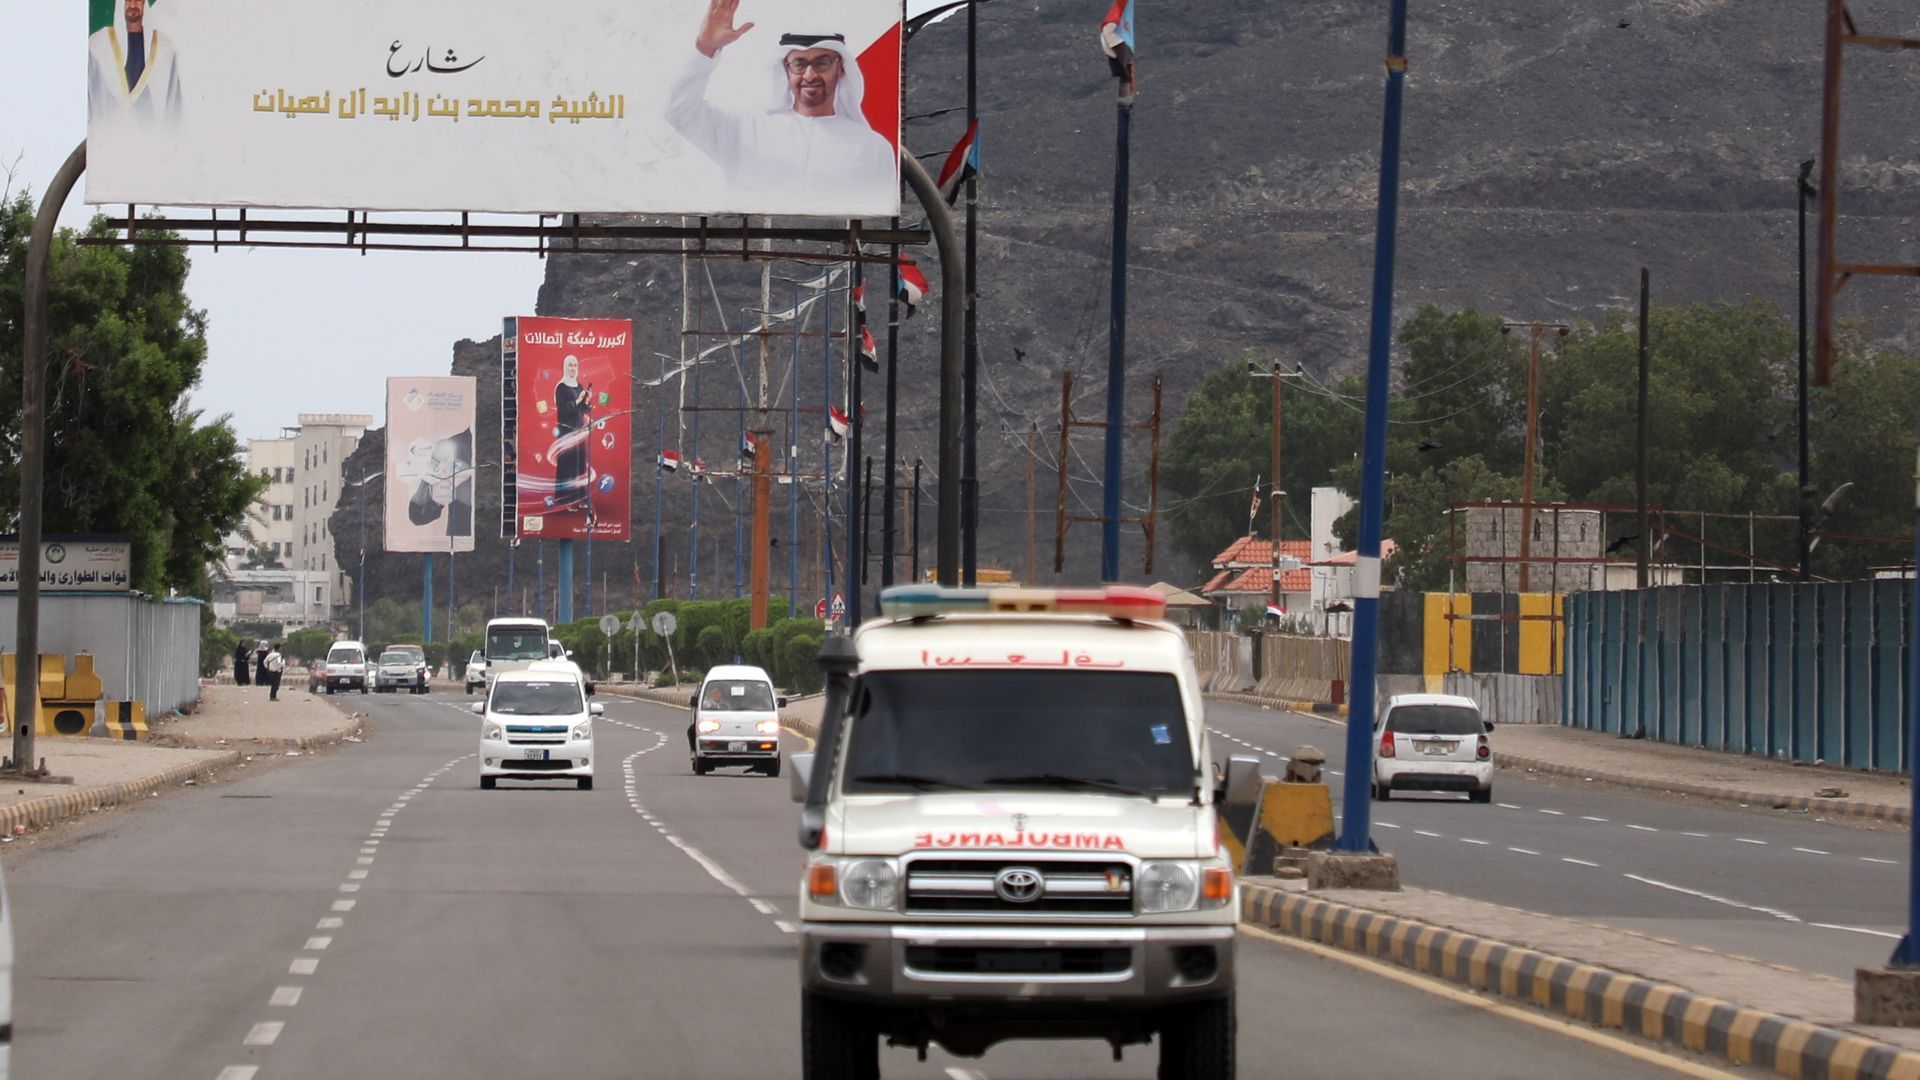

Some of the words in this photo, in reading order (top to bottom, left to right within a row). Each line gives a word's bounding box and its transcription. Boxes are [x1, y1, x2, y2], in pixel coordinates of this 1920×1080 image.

[386, 38, 486, 78] شارع
[252, 88, 331, 119] نهيان
[338, 87, 366, 119] آل
[373, 91, 420, 122] زايد
[427, 93, 460, 123] بن
[467, 99, 541, 119] محمد
[549, 91, 625, 125] الشيخ
[525, 332, 563, 348] إتصالات
[567, 331, 595, 348] شبكة
[58, 570, 99, 586] الطوارئ
[101, 570, 127, 586] قوات
